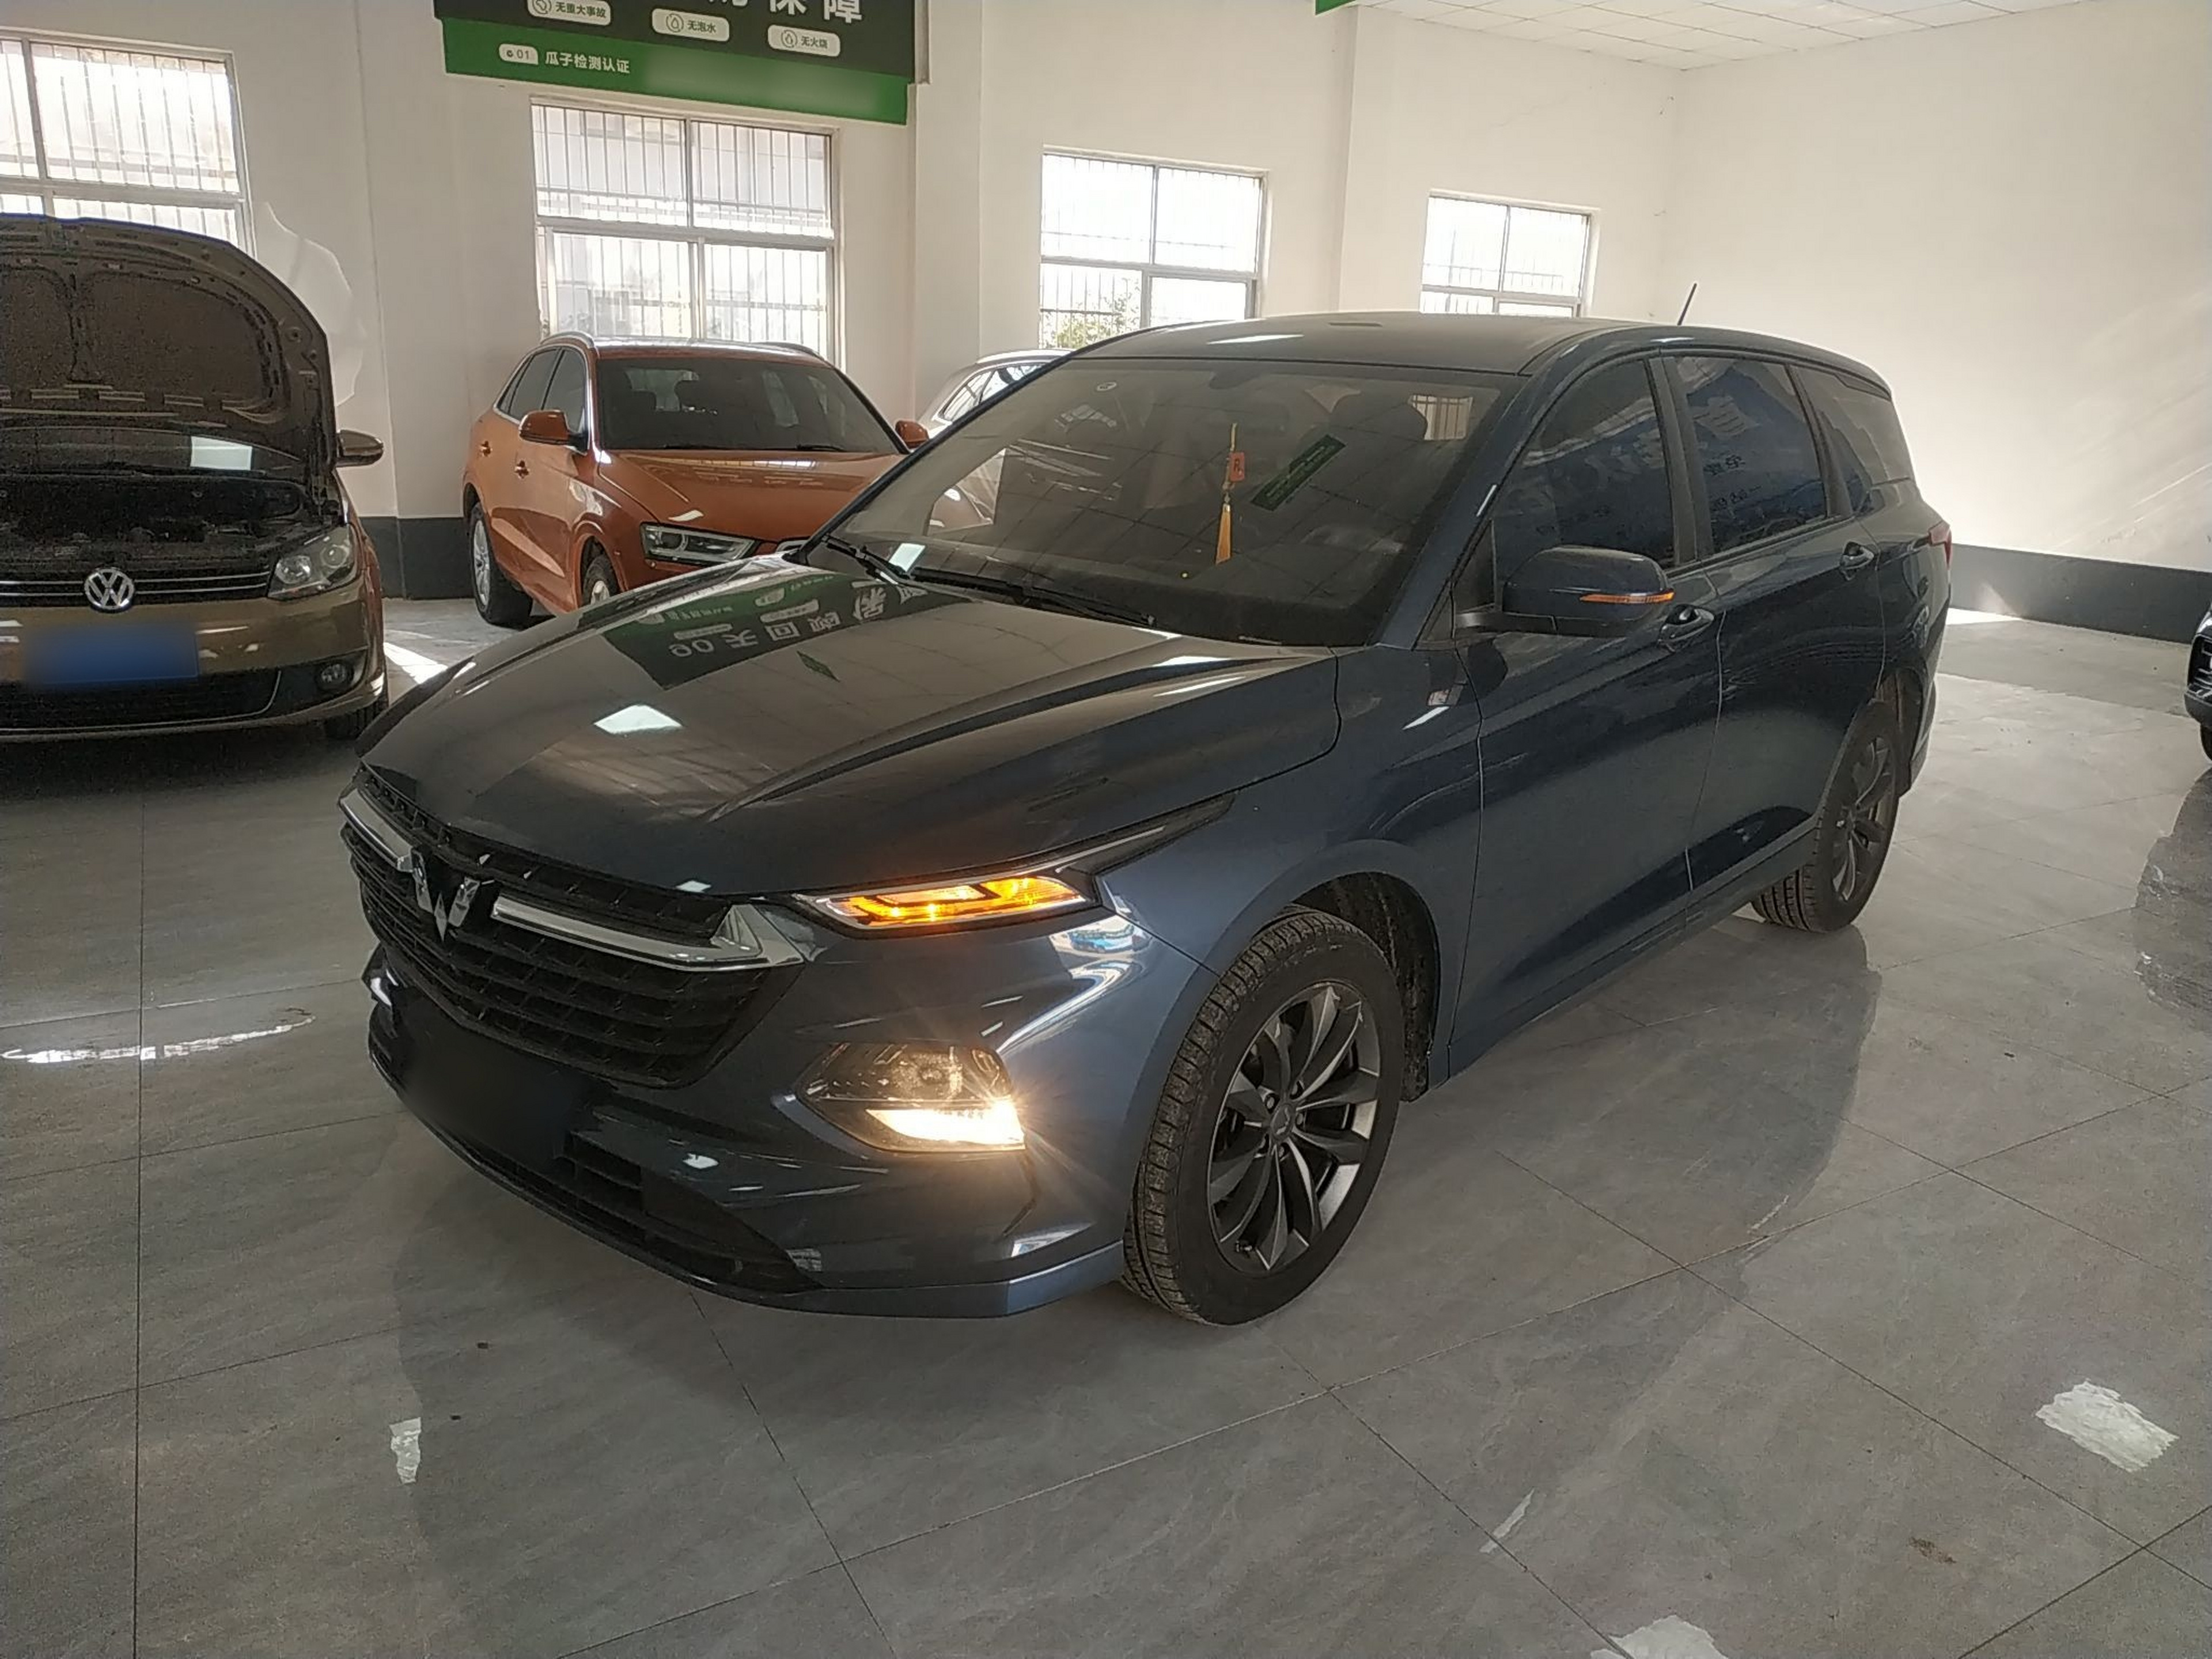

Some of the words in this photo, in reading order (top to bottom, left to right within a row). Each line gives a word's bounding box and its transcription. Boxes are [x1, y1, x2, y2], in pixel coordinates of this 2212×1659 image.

[555, 2, 606, 18] 无重大事故
[687, 20, 716, 33] 无泡水
[801, 36, 828, 49] 无火烧
[545, 51, 630, 73] 瓜子检测认证
